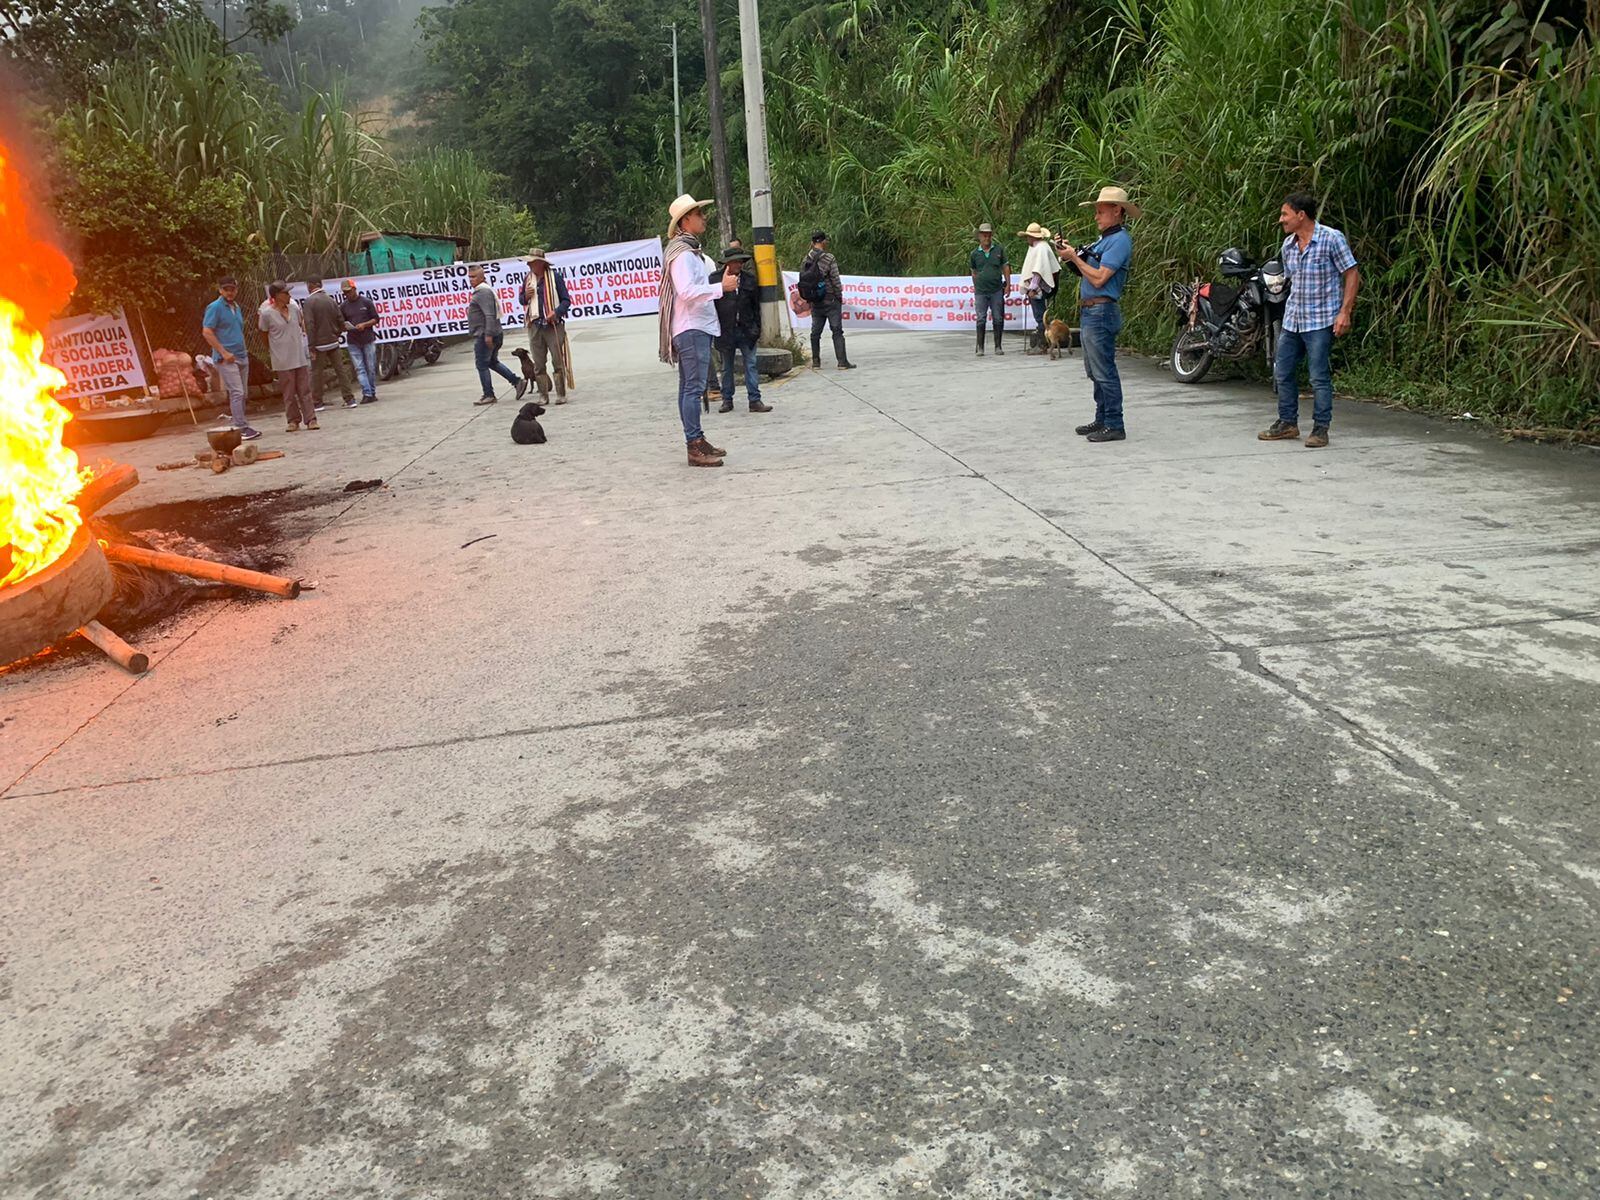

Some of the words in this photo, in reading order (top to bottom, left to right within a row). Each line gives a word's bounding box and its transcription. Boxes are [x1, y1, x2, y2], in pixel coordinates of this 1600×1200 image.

[381, 288, 396, 300] DE
[398, 279, 449, 298] MEDELLIN
[569, 265, 577, 278] Y
[580, 255, 662, 277] CORANTIOQUIA
[422, 262, 501, 281] SEÑOES
[376, 301, 391, 314] DE
[393, 298, 413, 312] LAS
[596, 276, 604, 288] Y
[607, 269, 661, 287] SOCIALES
[877, 284, 900, 294] nos
[904, 284, 975, 296] dejaremos
[434, 309, 442, 322] Y
[597, 290, 612, 303] LA
[900, 298, 954, 309] Pradera
[959, 299, 966, 310] y
[854, 309, 876, 321] vía
[880, 311, 933, 321] Pradera
[426, 320, 469, 334] VERE
[60, 341, 133, 364] SOCIALES,
[70, 358, 136, 379] PRADERA
